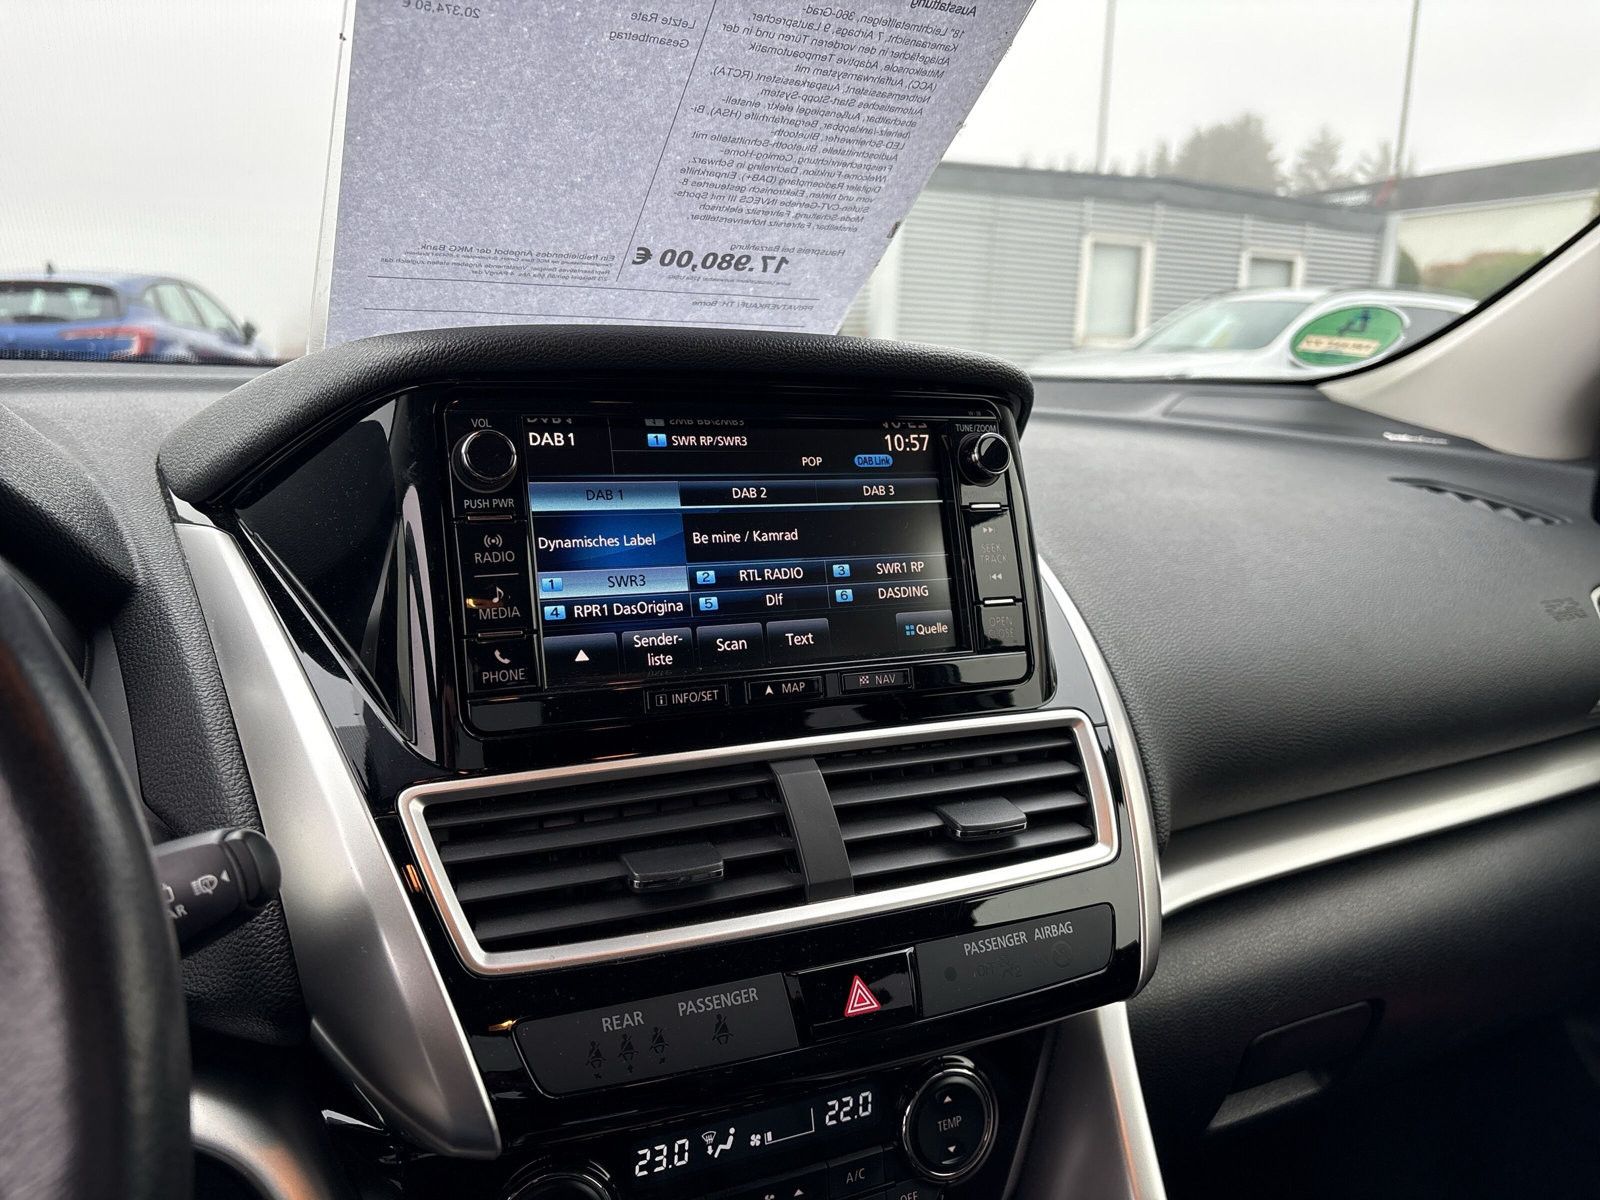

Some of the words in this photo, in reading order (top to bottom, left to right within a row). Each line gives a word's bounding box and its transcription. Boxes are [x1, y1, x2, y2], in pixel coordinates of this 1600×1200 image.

[471, 419, 492, 428] VOL
[955, 423, 997, 433] TUNE/ZOOM
[672, 435, 697, 446] SWR
[700, 435, 748, 447] RP/SWR3
[884, 434, 929, 452] 10:57
[802, 456, 822, 467] POP
[857, 456, 873, 466] DAB
[874, 456, 890, 467] Link
[585, 489, 614, 501] DAB
[618, 489, 624, 500] 1
[732, 487, 757, 499] DAB
[760, 487, 767, 498] 2
[863, 485, 886, 496] DAB
[888, 485, 895, 496] 3
[464, 499, 490, 509] PUSH
[492, 498, 515, 509] PWR
[538, 535, 620, 551] Dynamisches
[623, 533, 656, 547] Label
[693, 532, 708, 544] Be
[711, 531, 741, 543] mine
[753, 529, 798, 542] Kamrad
[474, 551, 515, 564] RADIO
[740, 569, 762, 581] RTL
[765, 567, 804, 580] RADIO
[876, 562, 908, 575] SWR1
[911, 561, 924, 573] RP
[607, 575, 646, 588] SWR3
[878, 585, 929, 599] DASDING
[479, 606, 520, 620] MEDIA
[574, 603, 609, 618] RPR1
[613, 601, 683, 618] DasOrigina
[916, 622, 948, 636] Quelle
[633, 632, 683, 648] Sender-
[716, 638, 747, 651] Scan
[786, 633, 814, 646] Text
[648, 653, 673, 666] liste
[482, 669, 525, 684] PHONE
[875, 674, 895, 685] NAV
[782, 682, 805, 694] MAP
[672, 690, 719, 704] INFO/SET
[964, 931, 1027, 956] PASSENGER
[1034, 921, 1073, 941] AIRBAG
[678, 987, 759, 1017] PASSENGER
[602, 1011, 645, 1032] REAR
[825, 1091, 873, 1126] 22.0
[938, 1115, 962, 1132] TEMP
[635, 1138, 689, 1177] 23.0
[846, 1168, 866, 1183] A/C
